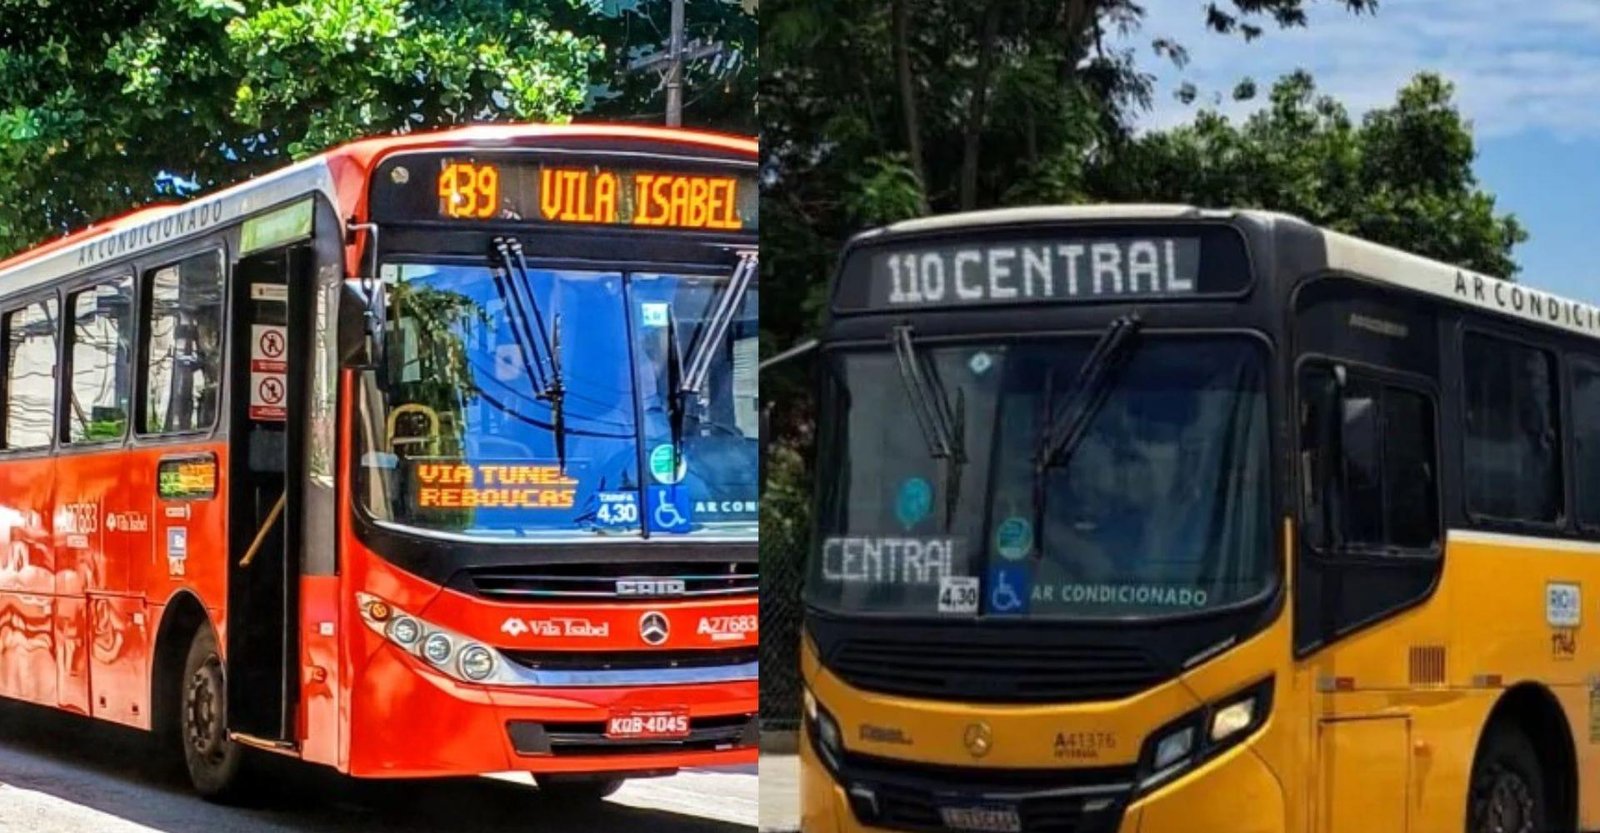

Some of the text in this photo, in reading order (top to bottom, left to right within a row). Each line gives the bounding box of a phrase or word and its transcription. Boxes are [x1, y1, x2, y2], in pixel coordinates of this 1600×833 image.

[437, 163, 743, 230] 439 VILA ISABEL
[887, 239, 1193, 303] 110 CENTRAL
[1454, 271, 1600, 329] AR CONDICI
[418, 464, 474, 483] VIA
[596, 503, 638, 525] 4,30
[695, 501, 717, 513] AR
[822, 537, 955, 583] CENTRAL
[941, 587, 976, 609] 4,30
[1030, 585, 1209, 606] AR CONDICIONADO
[530, 618, 609, 637] Vila Isabel
[696, 614, 759, 635] A27683
